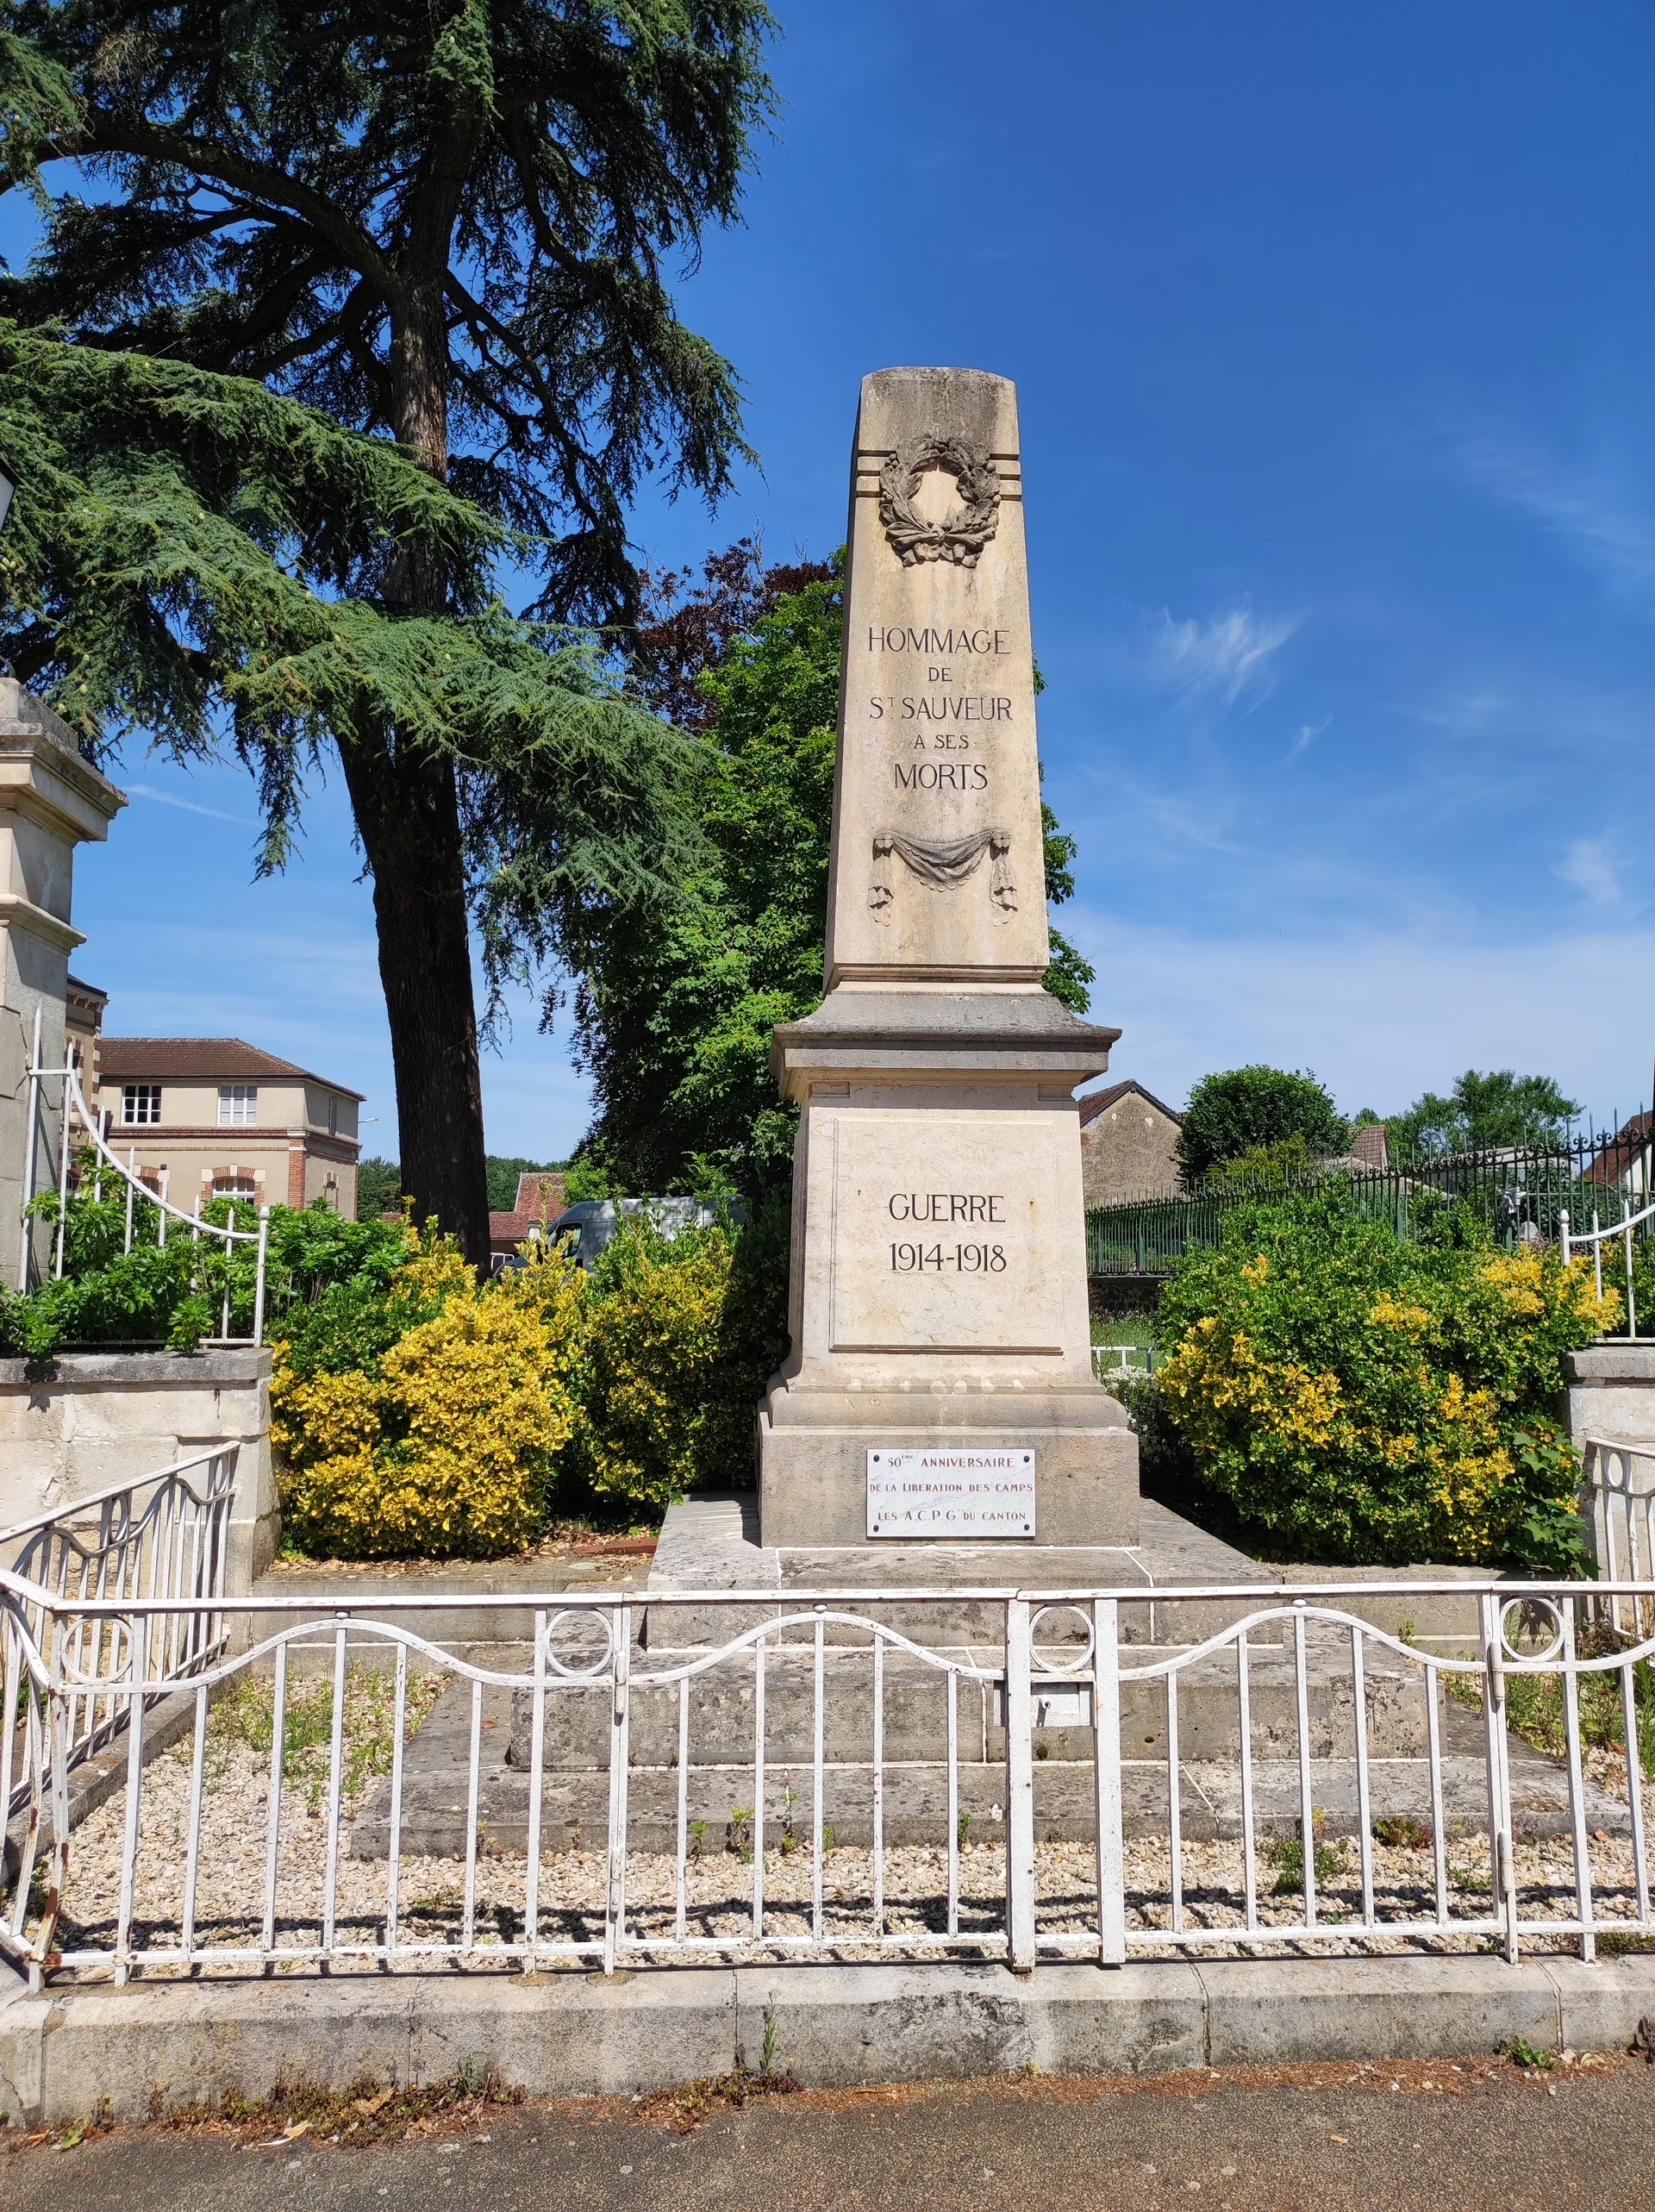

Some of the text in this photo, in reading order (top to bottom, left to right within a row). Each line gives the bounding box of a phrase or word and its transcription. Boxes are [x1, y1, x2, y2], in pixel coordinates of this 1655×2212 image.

[868, 627, 1011, 654] HOMMAGE
[927, 666, 953, 682] DE
[902, 697, 1013, 721] SAUVEUR
[914, 734, 970, 749] A SES
[894, 763, 989, 790] MORTS
[889, 1193, 1007, 1222] GUERRE
[889, 1242, 1007, 1272] 1914-1918
[921, 1457, 1015, 1468] ANNIVERSAIRE
[870, 1483, 1033, 1492] DE LA LIBERATION DES CAMPS
[877, 1511, 897, 1522] LES
[963, 1511, 976, 1521] DU
[982, 1511, 1026, 1521] CANTON
